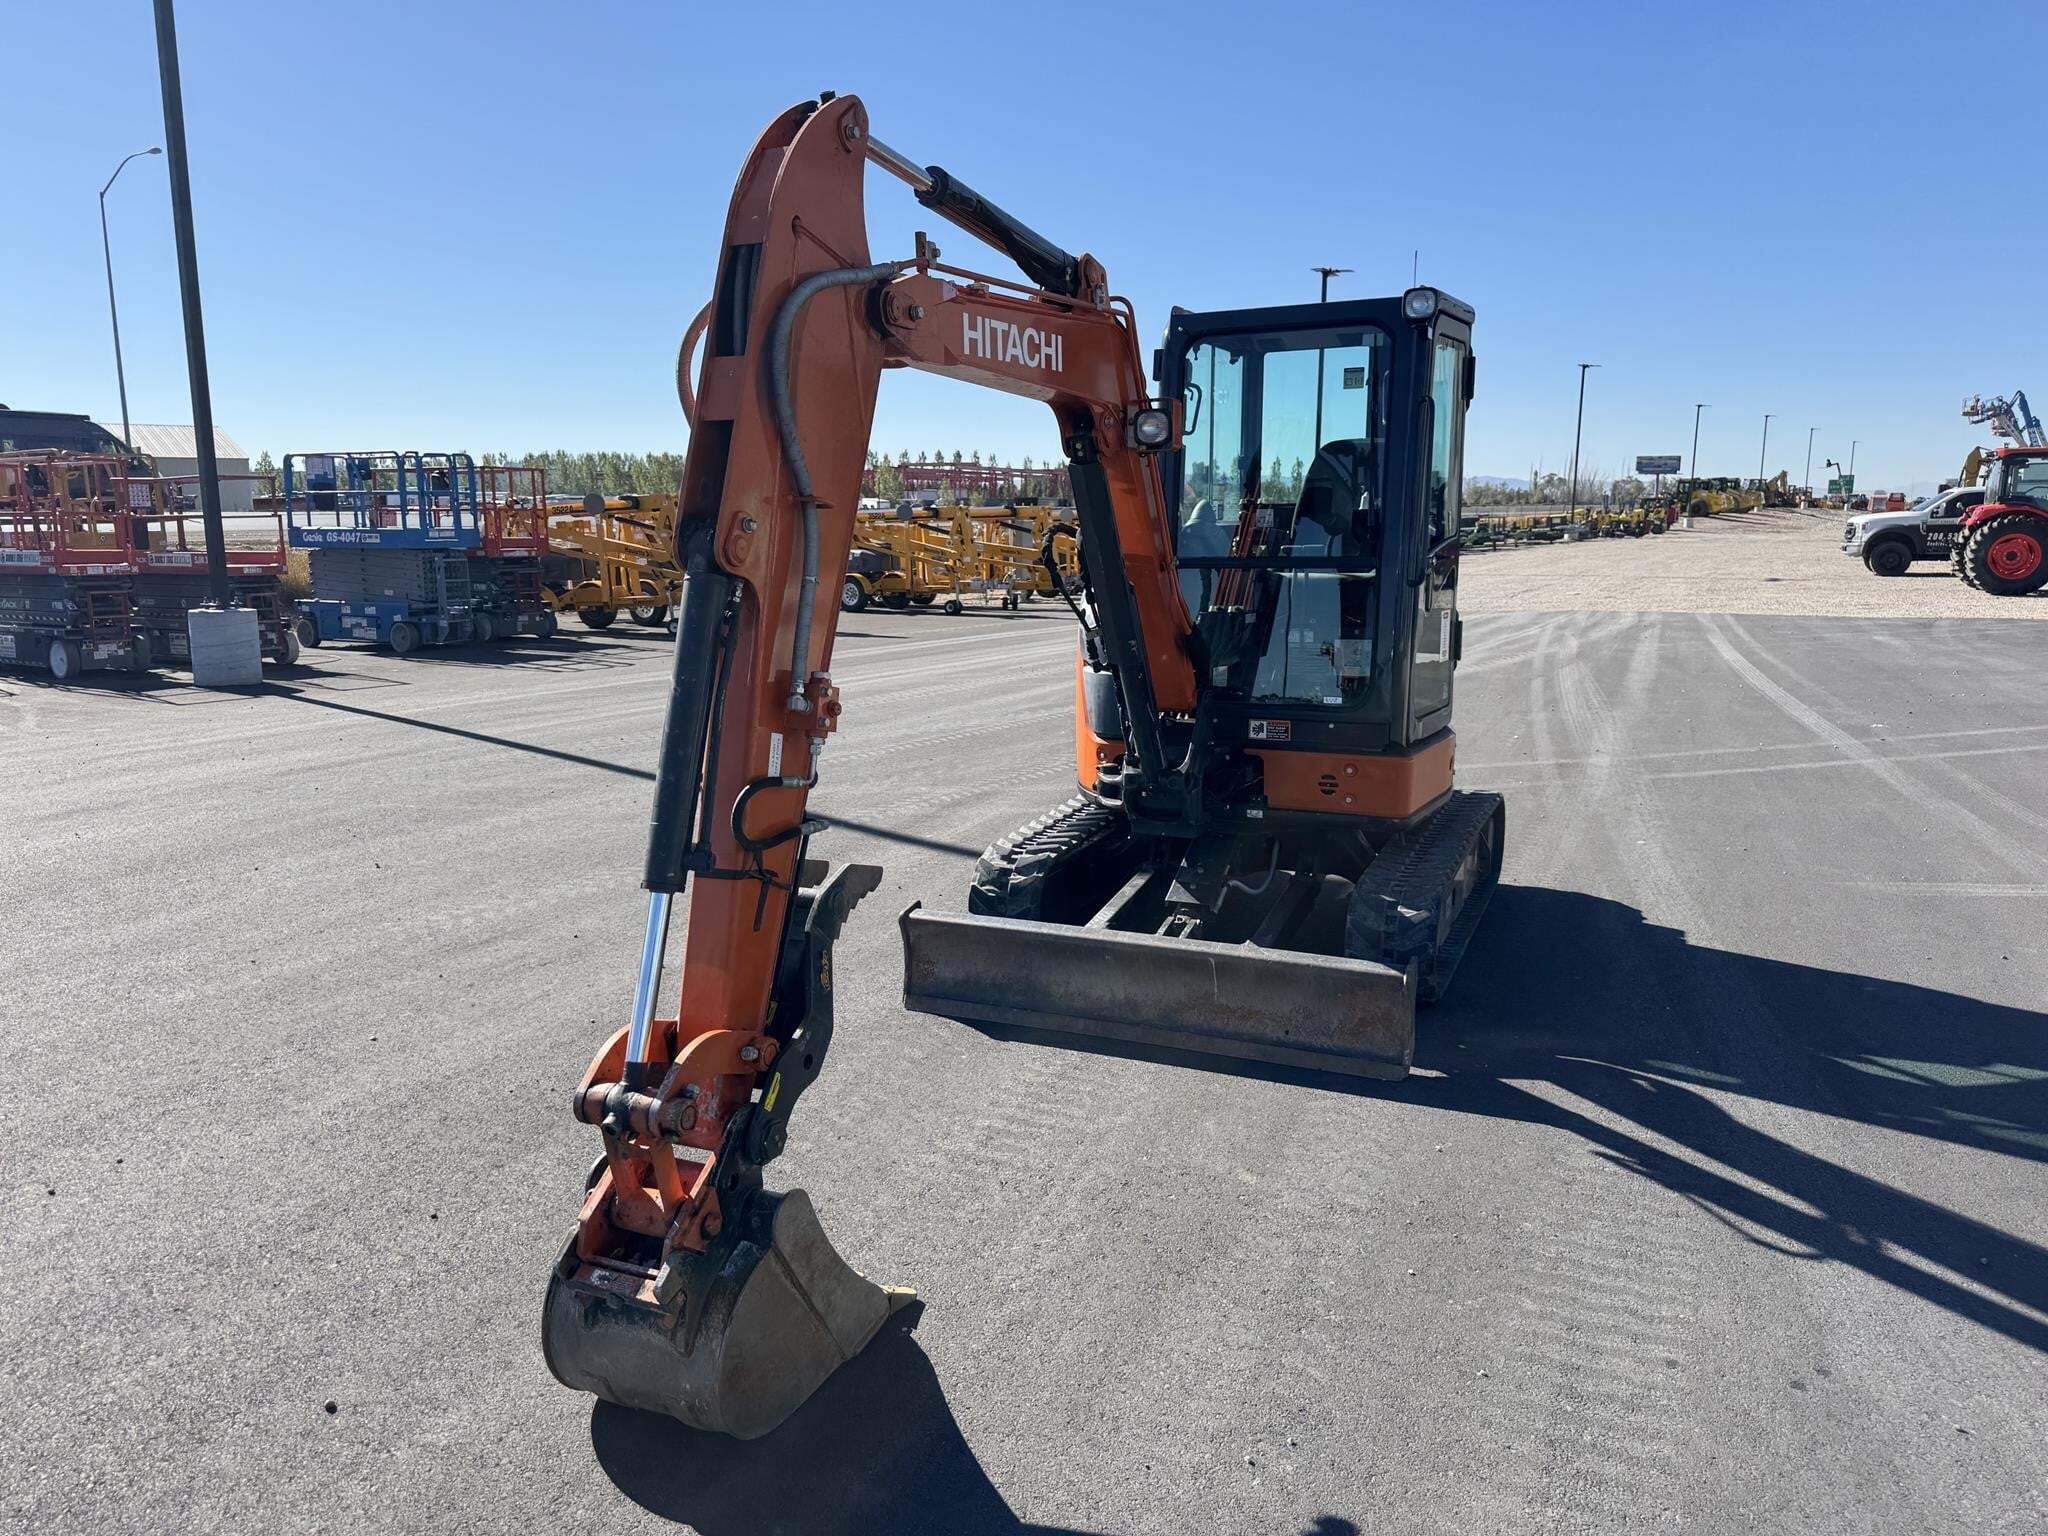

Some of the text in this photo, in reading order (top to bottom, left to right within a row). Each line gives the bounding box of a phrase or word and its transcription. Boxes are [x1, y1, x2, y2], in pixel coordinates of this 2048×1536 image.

[962, 312, 1063, 372] HITACHI
[302, 532, 323, 541] Genie
[326, 532, 361, 543] GS-4047
